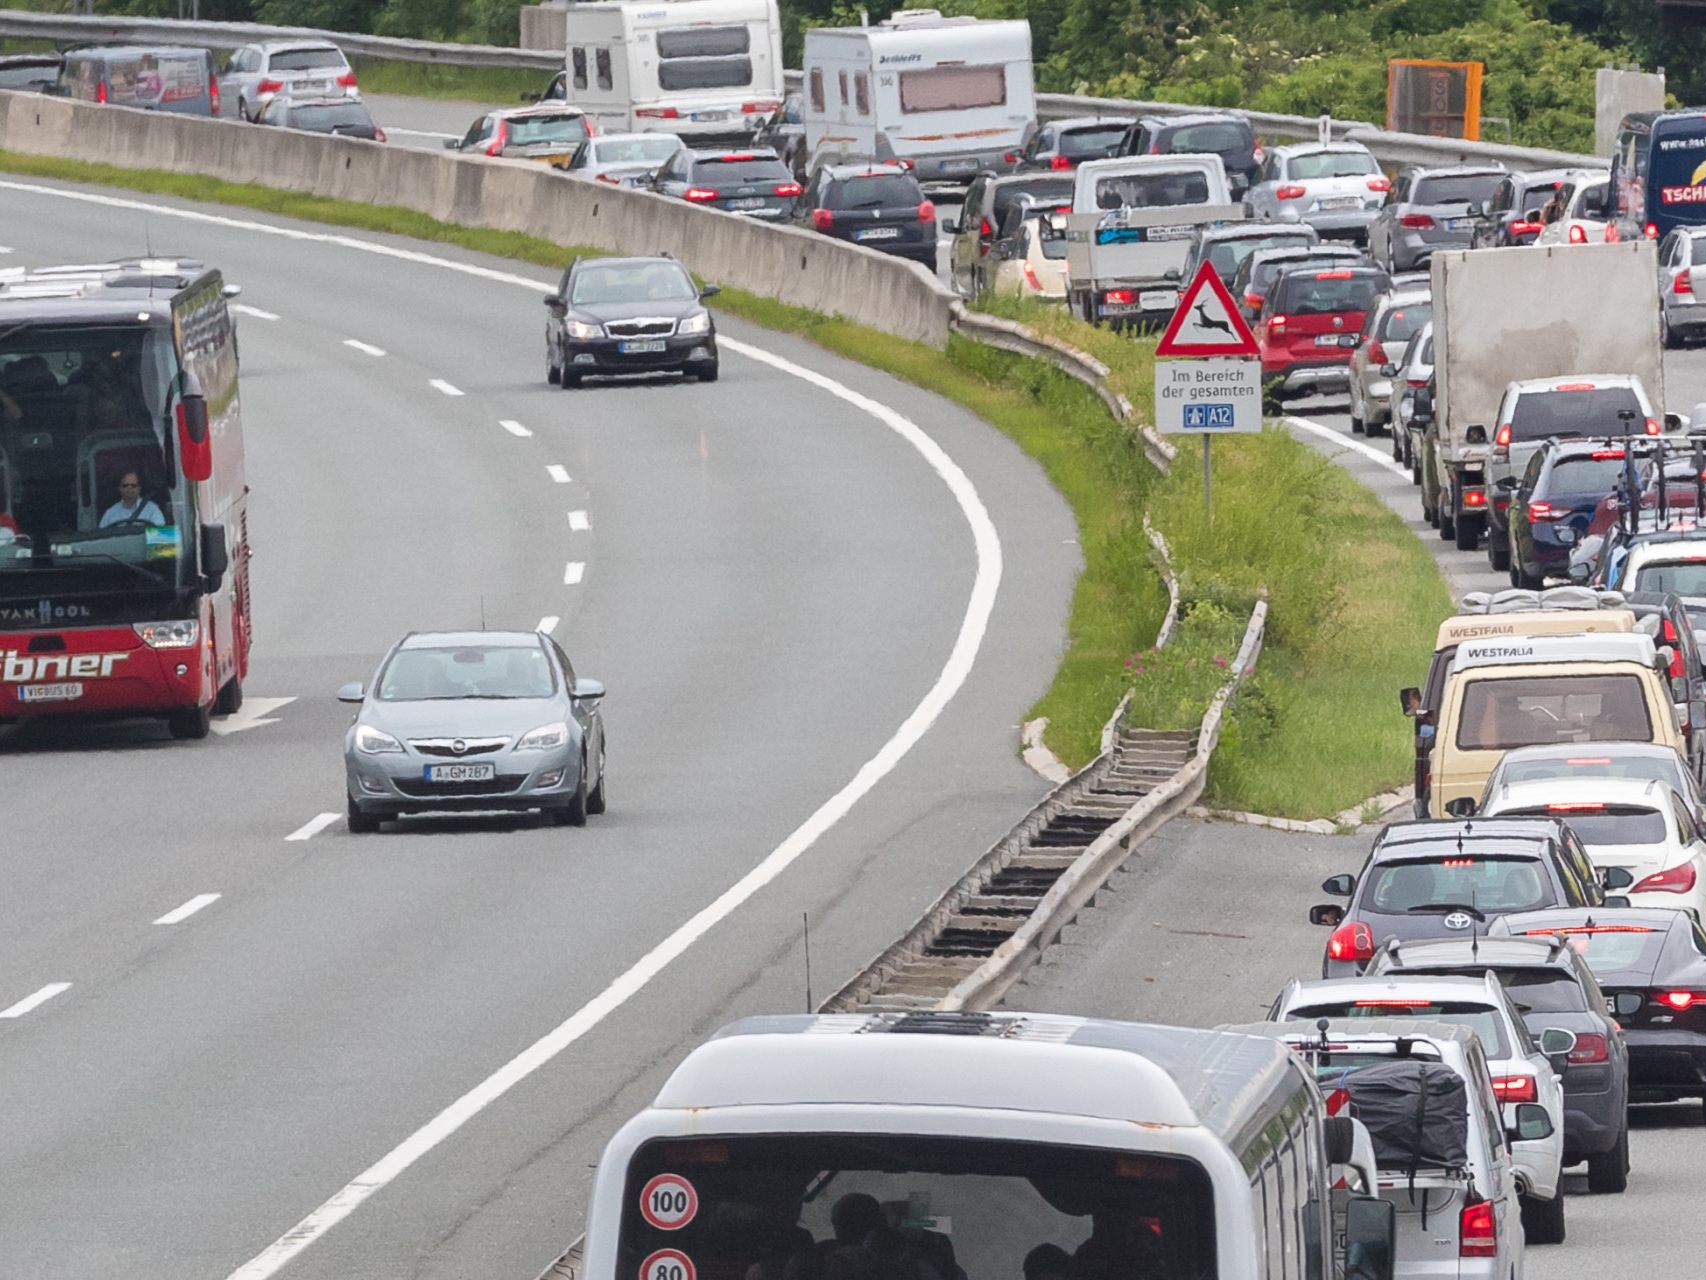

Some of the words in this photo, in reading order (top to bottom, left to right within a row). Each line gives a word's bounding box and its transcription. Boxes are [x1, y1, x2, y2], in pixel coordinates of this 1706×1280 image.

[1172, 369, 1190, 382] Im
[1195, 368, 1245, 382] Bereich
[1162, 385, 1184, 399] der
[1190, 386, 1254, 399] gesamten
[1209, 407, 1230, 423] A12
[1449, 625, 1515, 638] WESTFALIA
[1468, 647, 1534, 658] WESTFALIA
[652, 1191, 687, 1213] 100
